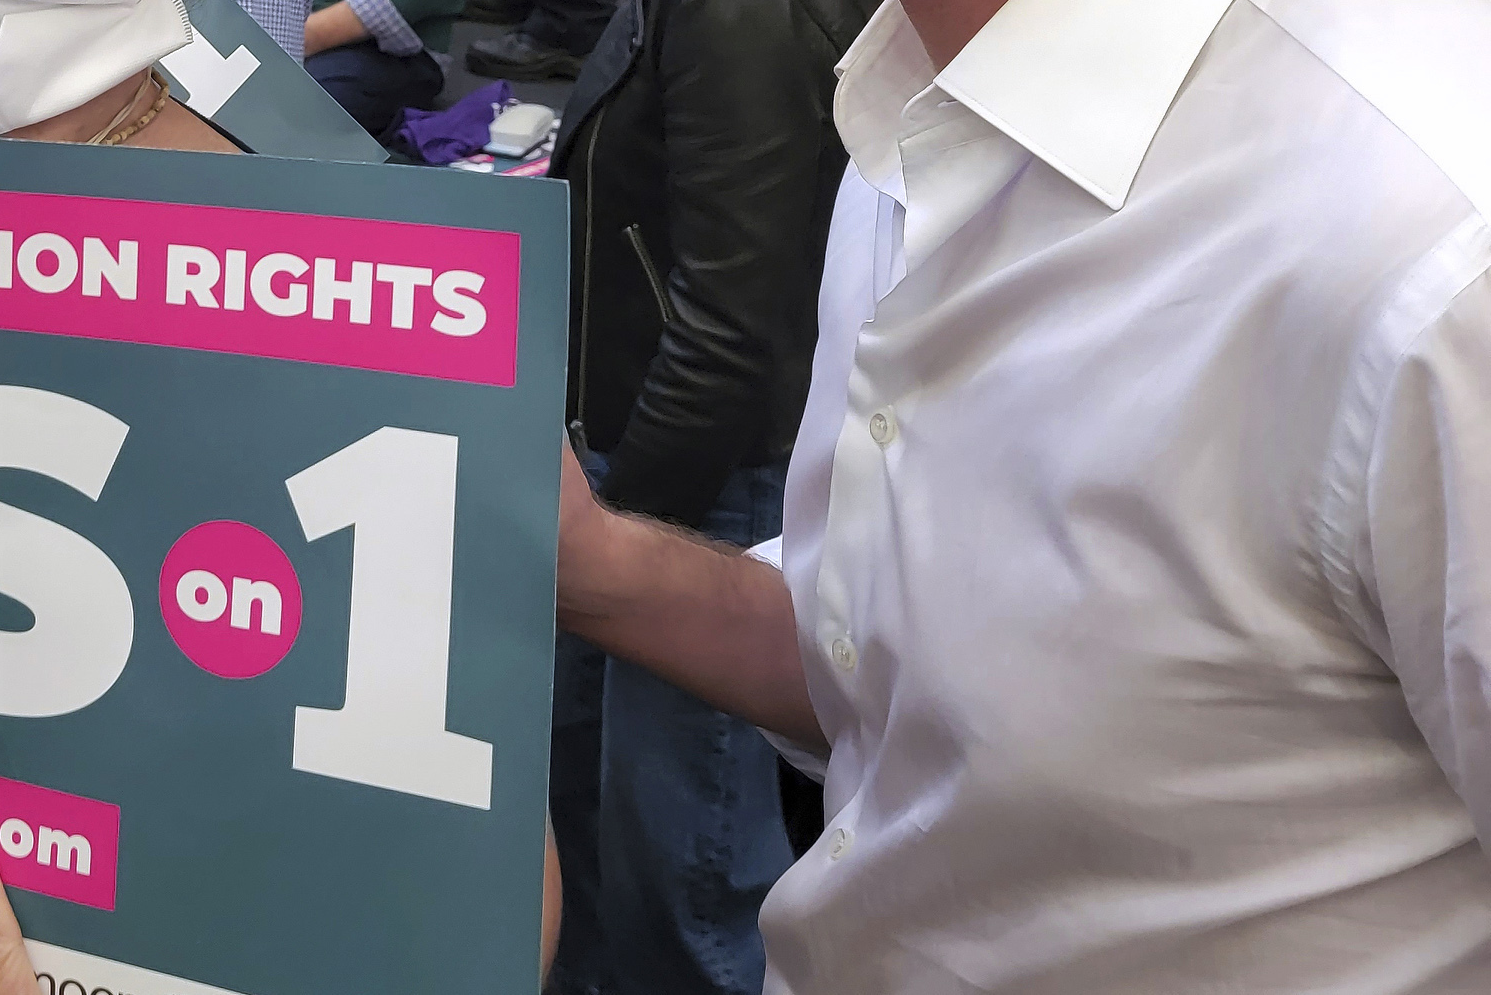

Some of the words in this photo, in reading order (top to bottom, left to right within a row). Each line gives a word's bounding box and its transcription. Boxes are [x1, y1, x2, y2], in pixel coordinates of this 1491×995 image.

[165, 243, 488, 338] RIGHTS
[175, 568, 283, 636] on
[284, 425, 494, 811] 1
